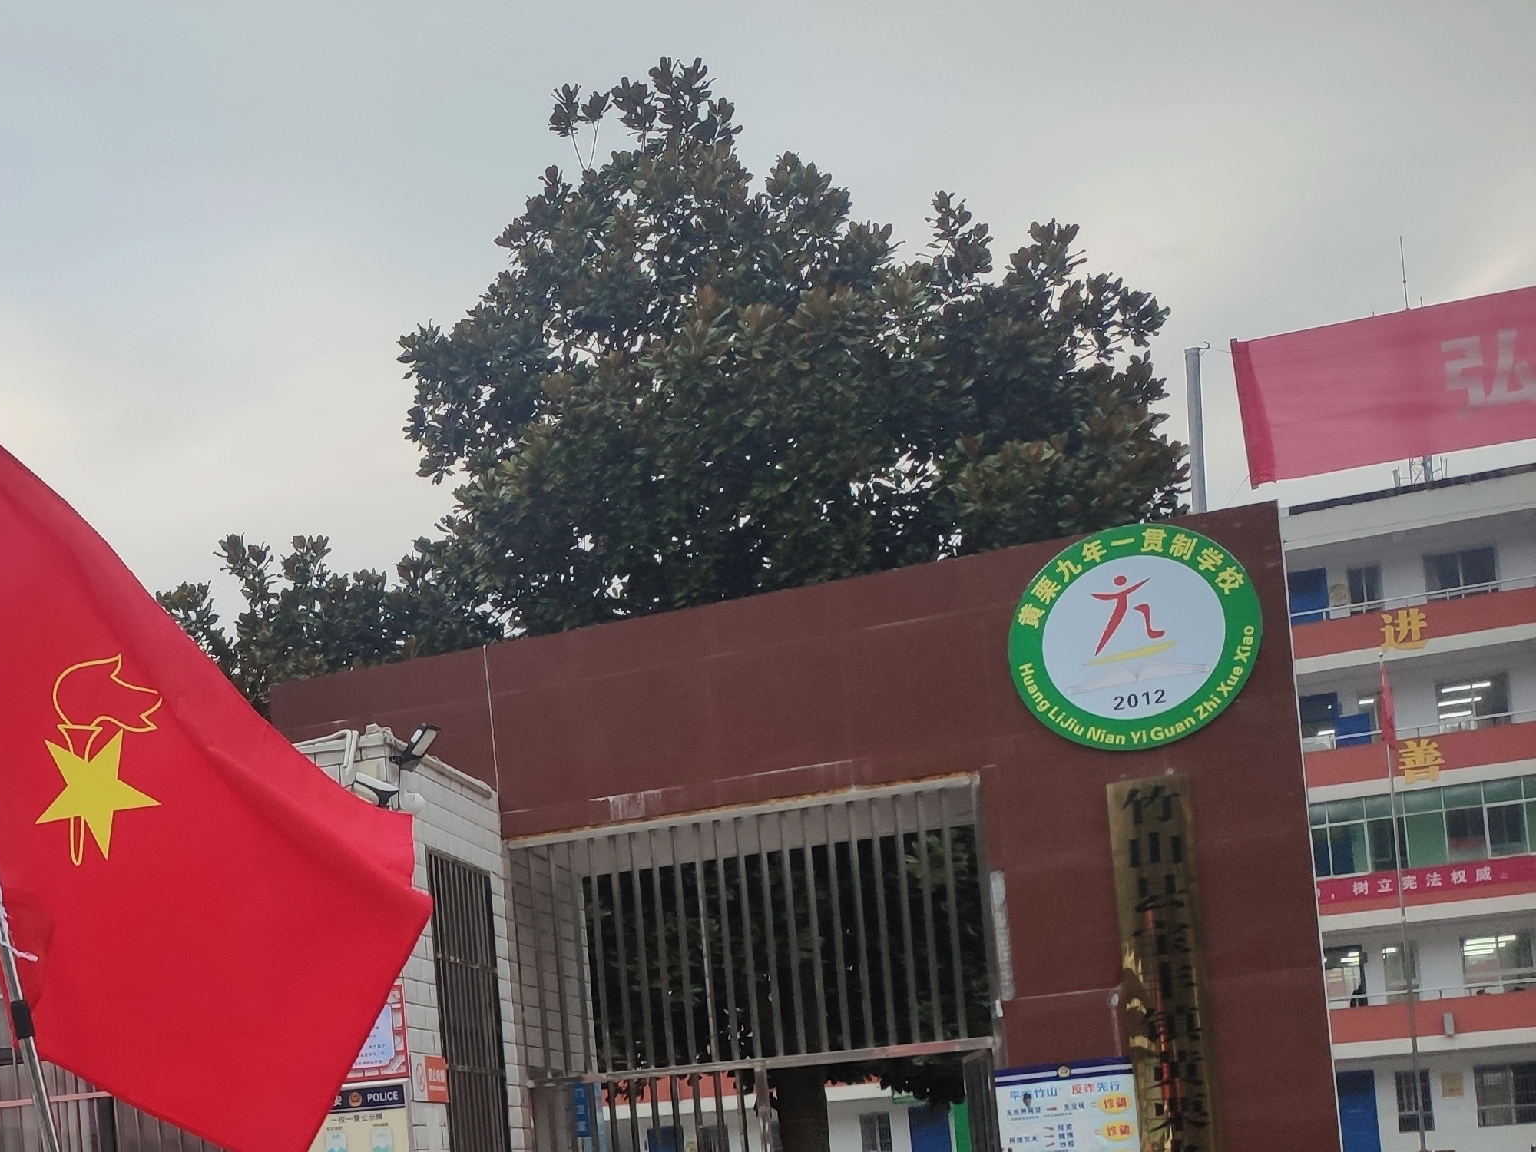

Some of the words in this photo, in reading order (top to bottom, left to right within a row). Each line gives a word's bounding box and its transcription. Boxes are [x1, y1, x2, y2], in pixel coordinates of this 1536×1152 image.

[1018, 528, 1244, 628] 黄栗九年一贯制学校
[1380, 608, 1429, 651] 进
[1018, 663, 1050, 711] Huang
[1086, 726, 1125, 745] Nian
[1130, 729, 1147, 744] Yi
[1150, 714, 1196, 741] Guan
[1194, 694, 1222, 720] Zhi
[1216, 665, 1244, 699] Xue
[1233, 625, 1255, 664] Xiao
[1113, 689, 1167, 711] 2012
[1398, 738, 1446, 785] 善
[366, 1090, 399, 1103] POLICE
